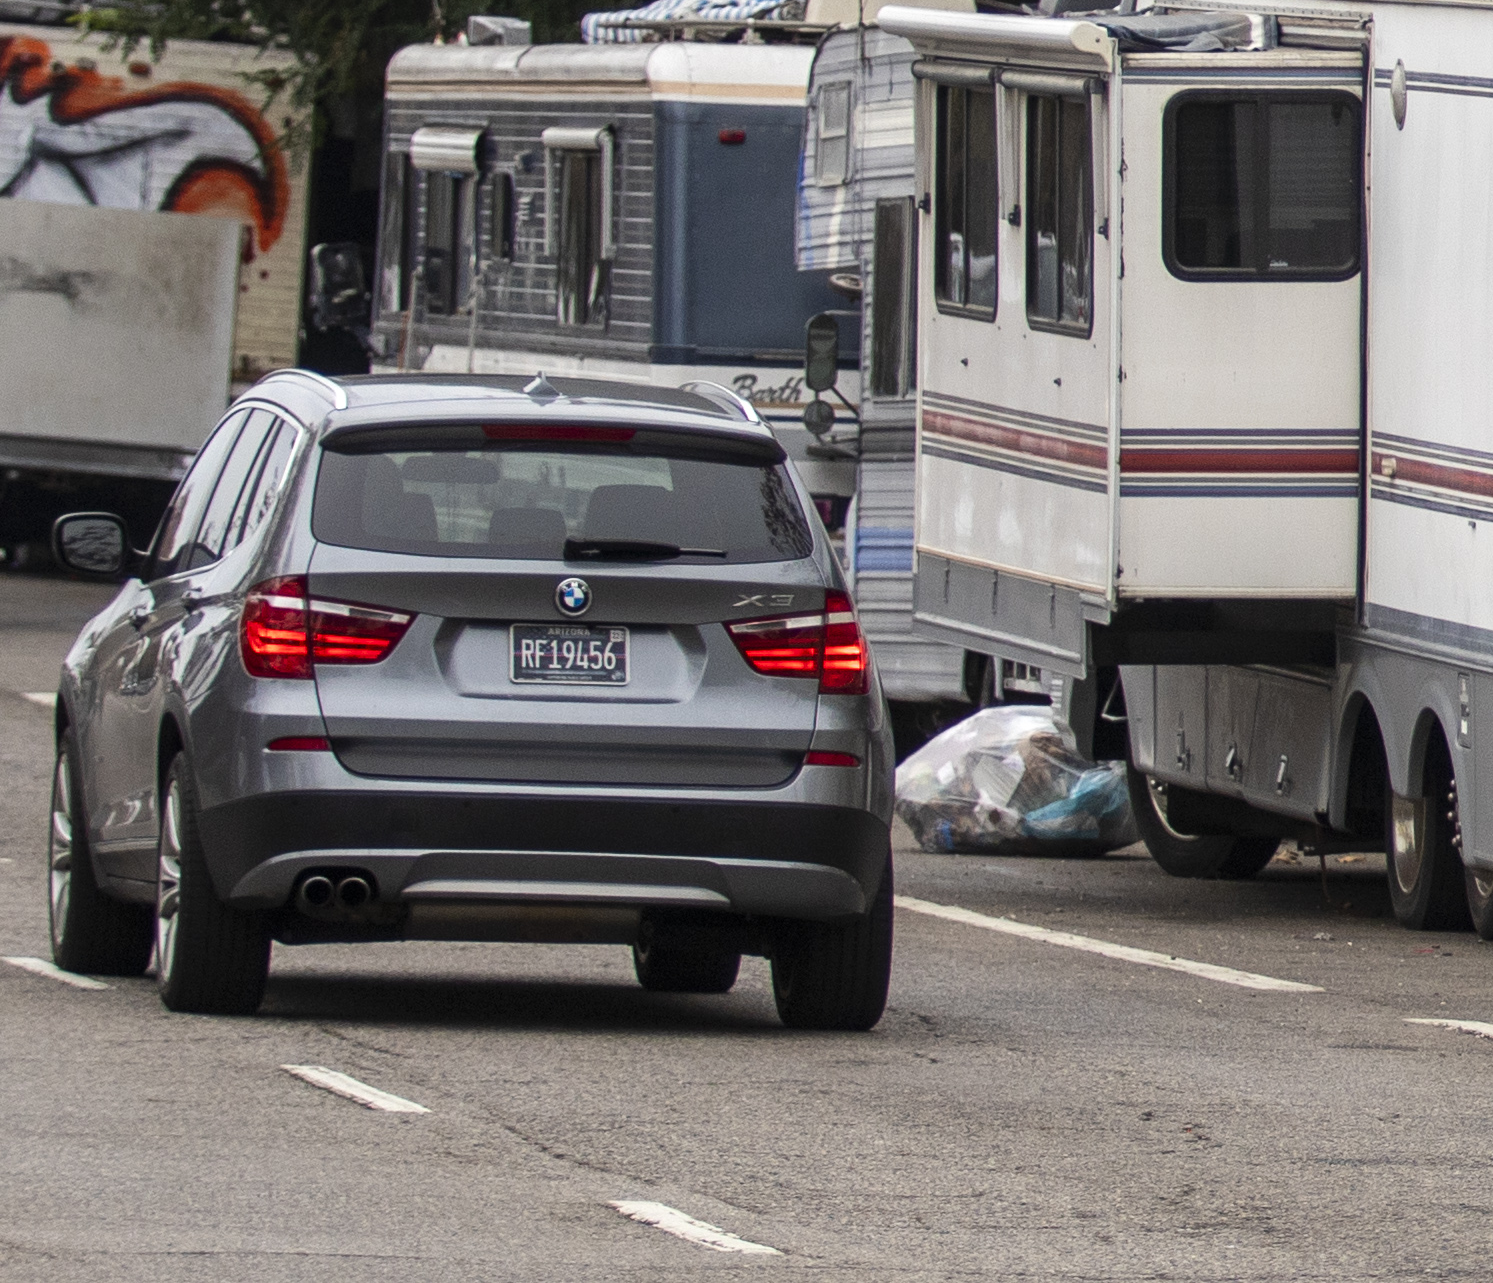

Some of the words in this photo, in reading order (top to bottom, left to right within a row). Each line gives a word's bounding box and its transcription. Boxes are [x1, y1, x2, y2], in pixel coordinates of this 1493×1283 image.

[733, 373, 804, 403] Barth
[732, 594, 794, 606] X3
[548, 628, 590, 636] ARIZONA
[522, 639, 616, 669] RF19456
